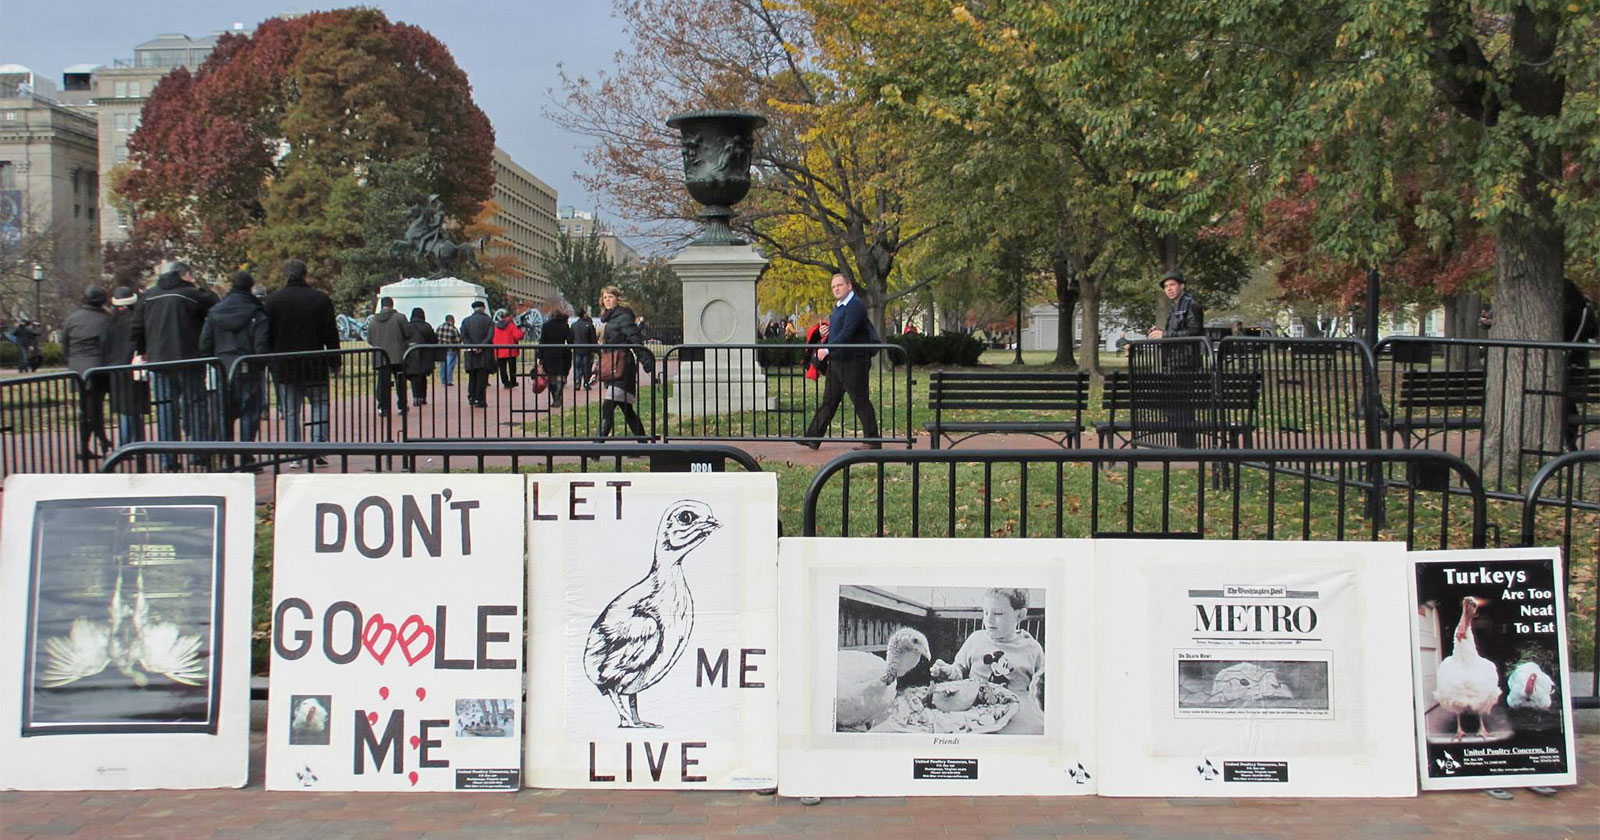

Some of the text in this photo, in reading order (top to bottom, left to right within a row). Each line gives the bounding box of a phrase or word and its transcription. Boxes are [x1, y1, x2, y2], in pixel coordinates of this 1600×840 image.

[532, 481, 632, 521] LET
[315, 488, 480, 559] DON'T
[1443, 567, 1527, 588] Turkeys
[1238, 587, 1270, 596] Washington
[1270, 587, 1284, 596] Post
[1501, 588, 1552, 600] Are Too
[1193, 604, 1318, 634] METRO
[1520, 604, 1554, 617] Neat
[273, 597, 518, 670] GOBBLE
[1514, 622, 1555, 634] To Eat
[695, 648, 767, 688] ME
[353, 709, 450, 775] ME
[933, 737, 961, 745] Friends
[1463, 748, 1485, 756] United
[1487, 748, 1510, 756] Poultry
[1546, 746, 1559, 754] Inc.
[589, 741, 707, 783] LIVE
